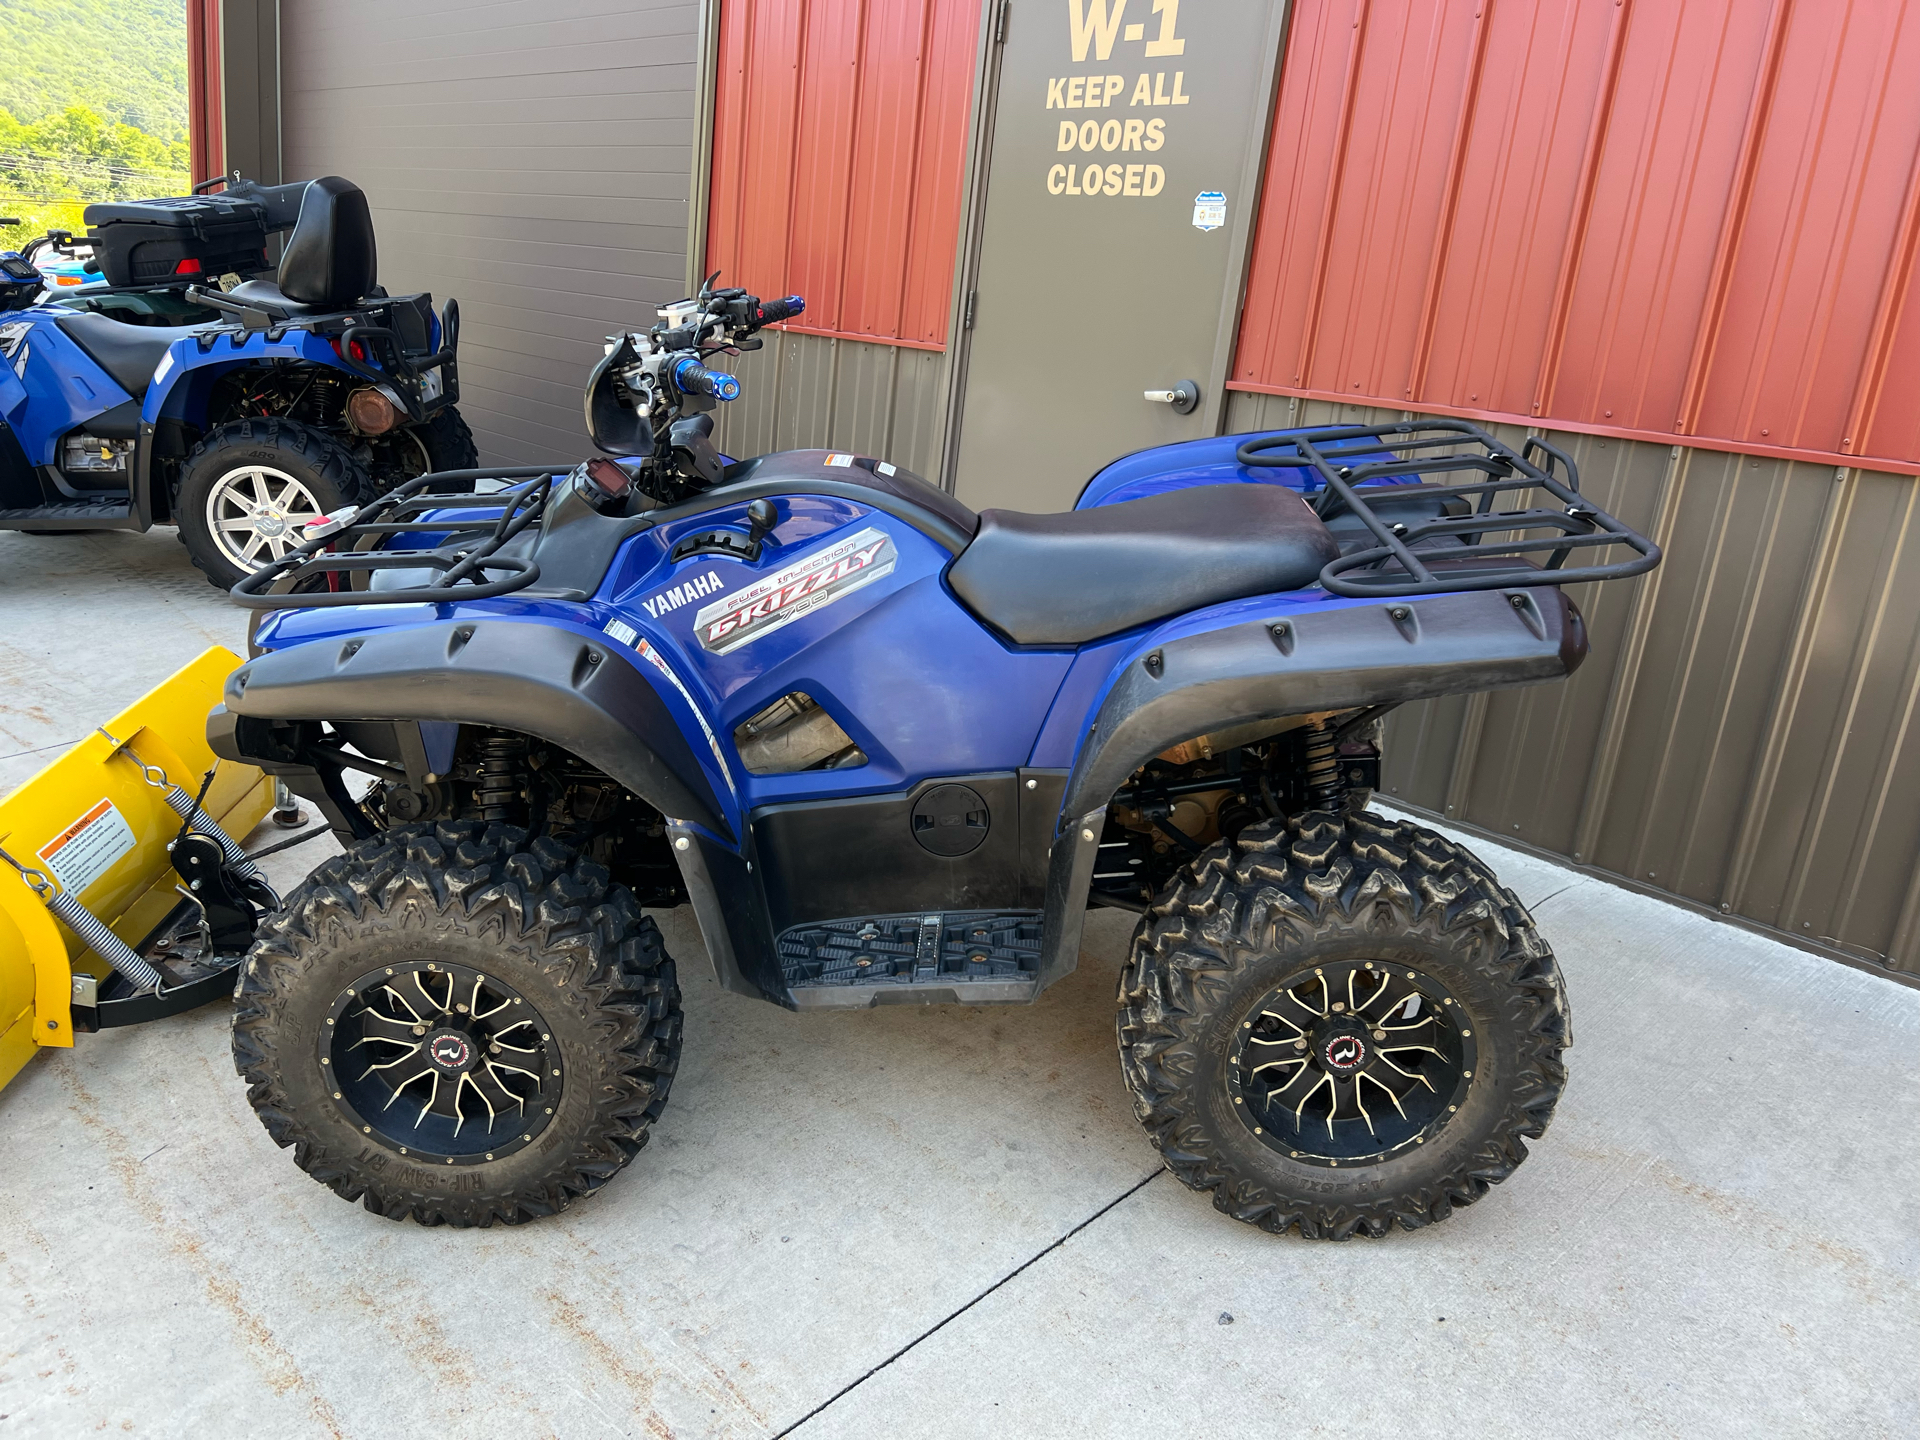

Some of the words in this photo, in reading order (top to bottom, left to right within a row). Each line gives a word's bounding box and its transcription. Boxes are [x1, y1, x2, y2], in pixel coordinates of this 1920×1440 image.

[1068, 0, 1185, 62] W-1
[1046, 75, 1125, 109] KEEP
[1129, 71, 1190, 106] ALL
[1057, 118, 1166, 152] DOORS
[1047, 163, 1166, 197] CLOSED
[248, 450, 276, 460] 489
[707, 539, 886, 643] GRIZZLY
[727, 585, 771, 610] FUEL
[777, 542, 855, 584] INJECTION
[642, 571, 724, 619] YAMAHA
[779, 590, 828, 621] 700
[69, 817, 91, 836] WARNING
[355, 1146, 391, 1174] R/T
[398, 1162, 485, 1192] RIP-SAW
